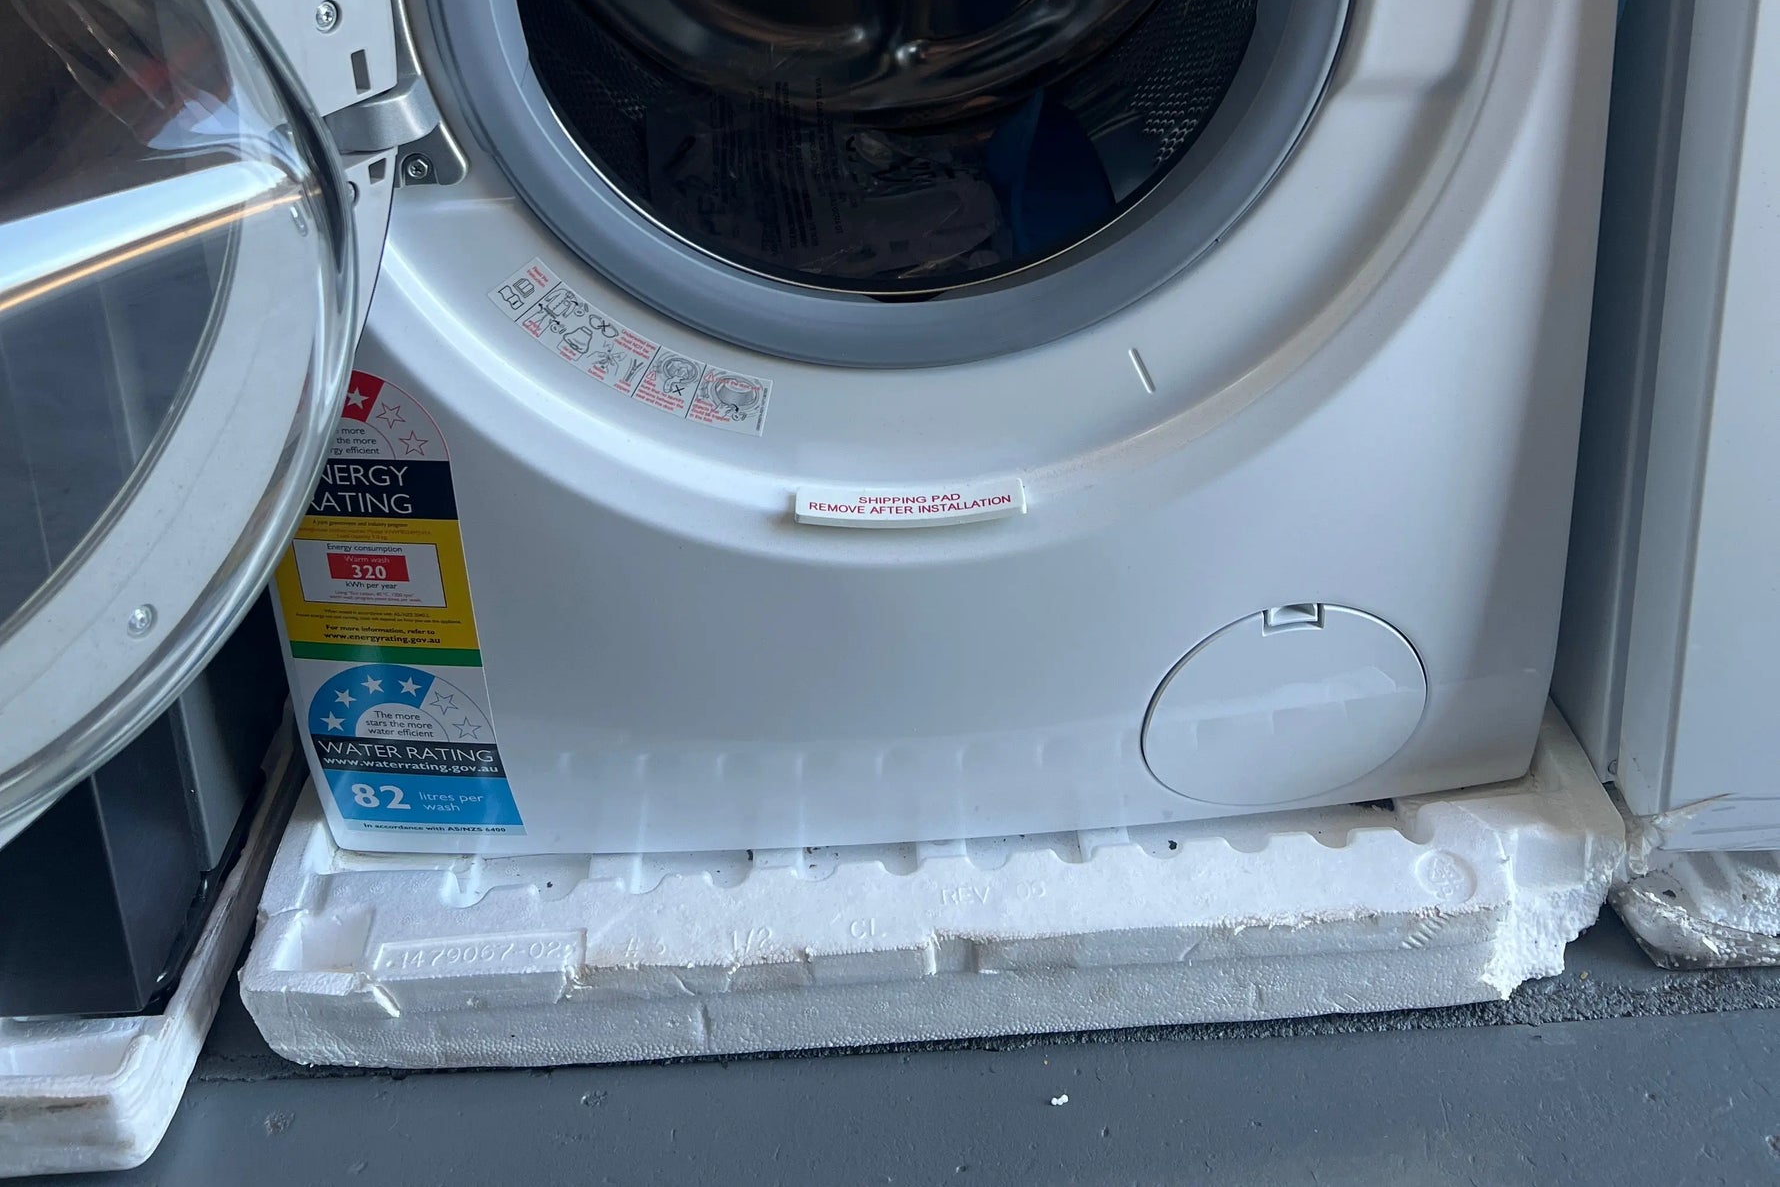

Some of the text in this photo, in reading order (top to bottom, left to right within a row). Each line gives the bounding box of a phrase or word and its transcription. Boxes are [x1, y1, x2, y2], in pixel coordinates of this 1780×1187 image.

[322, 465, 408, 486] NERGY
[310, 492, 412, 514] ATING
[809, 495, 1011, 514] REMOVE AFTER INSTALLATION
[859, 496, 926, 504] SHIPPING
[327, 543, 402, 553] Energy consumption
[344, 555, 368, 563] Warm
[352, 565, 387, 579] 320
[361, 626, 405, 634] information,
[324, 633, 440, 644] www.energyrating.gov.au
[374, 711, 393, 720] The
[399, 729, 434, 737] efficient
[318, 741, 493, 762] WATER RATING
[323, 757, 498, 773] www.waterrating.gov.au
[351, 784, 483, 810] 82 litres per
[423, 802, 460, 811] wash
[942, 885, 990, 905] REV
